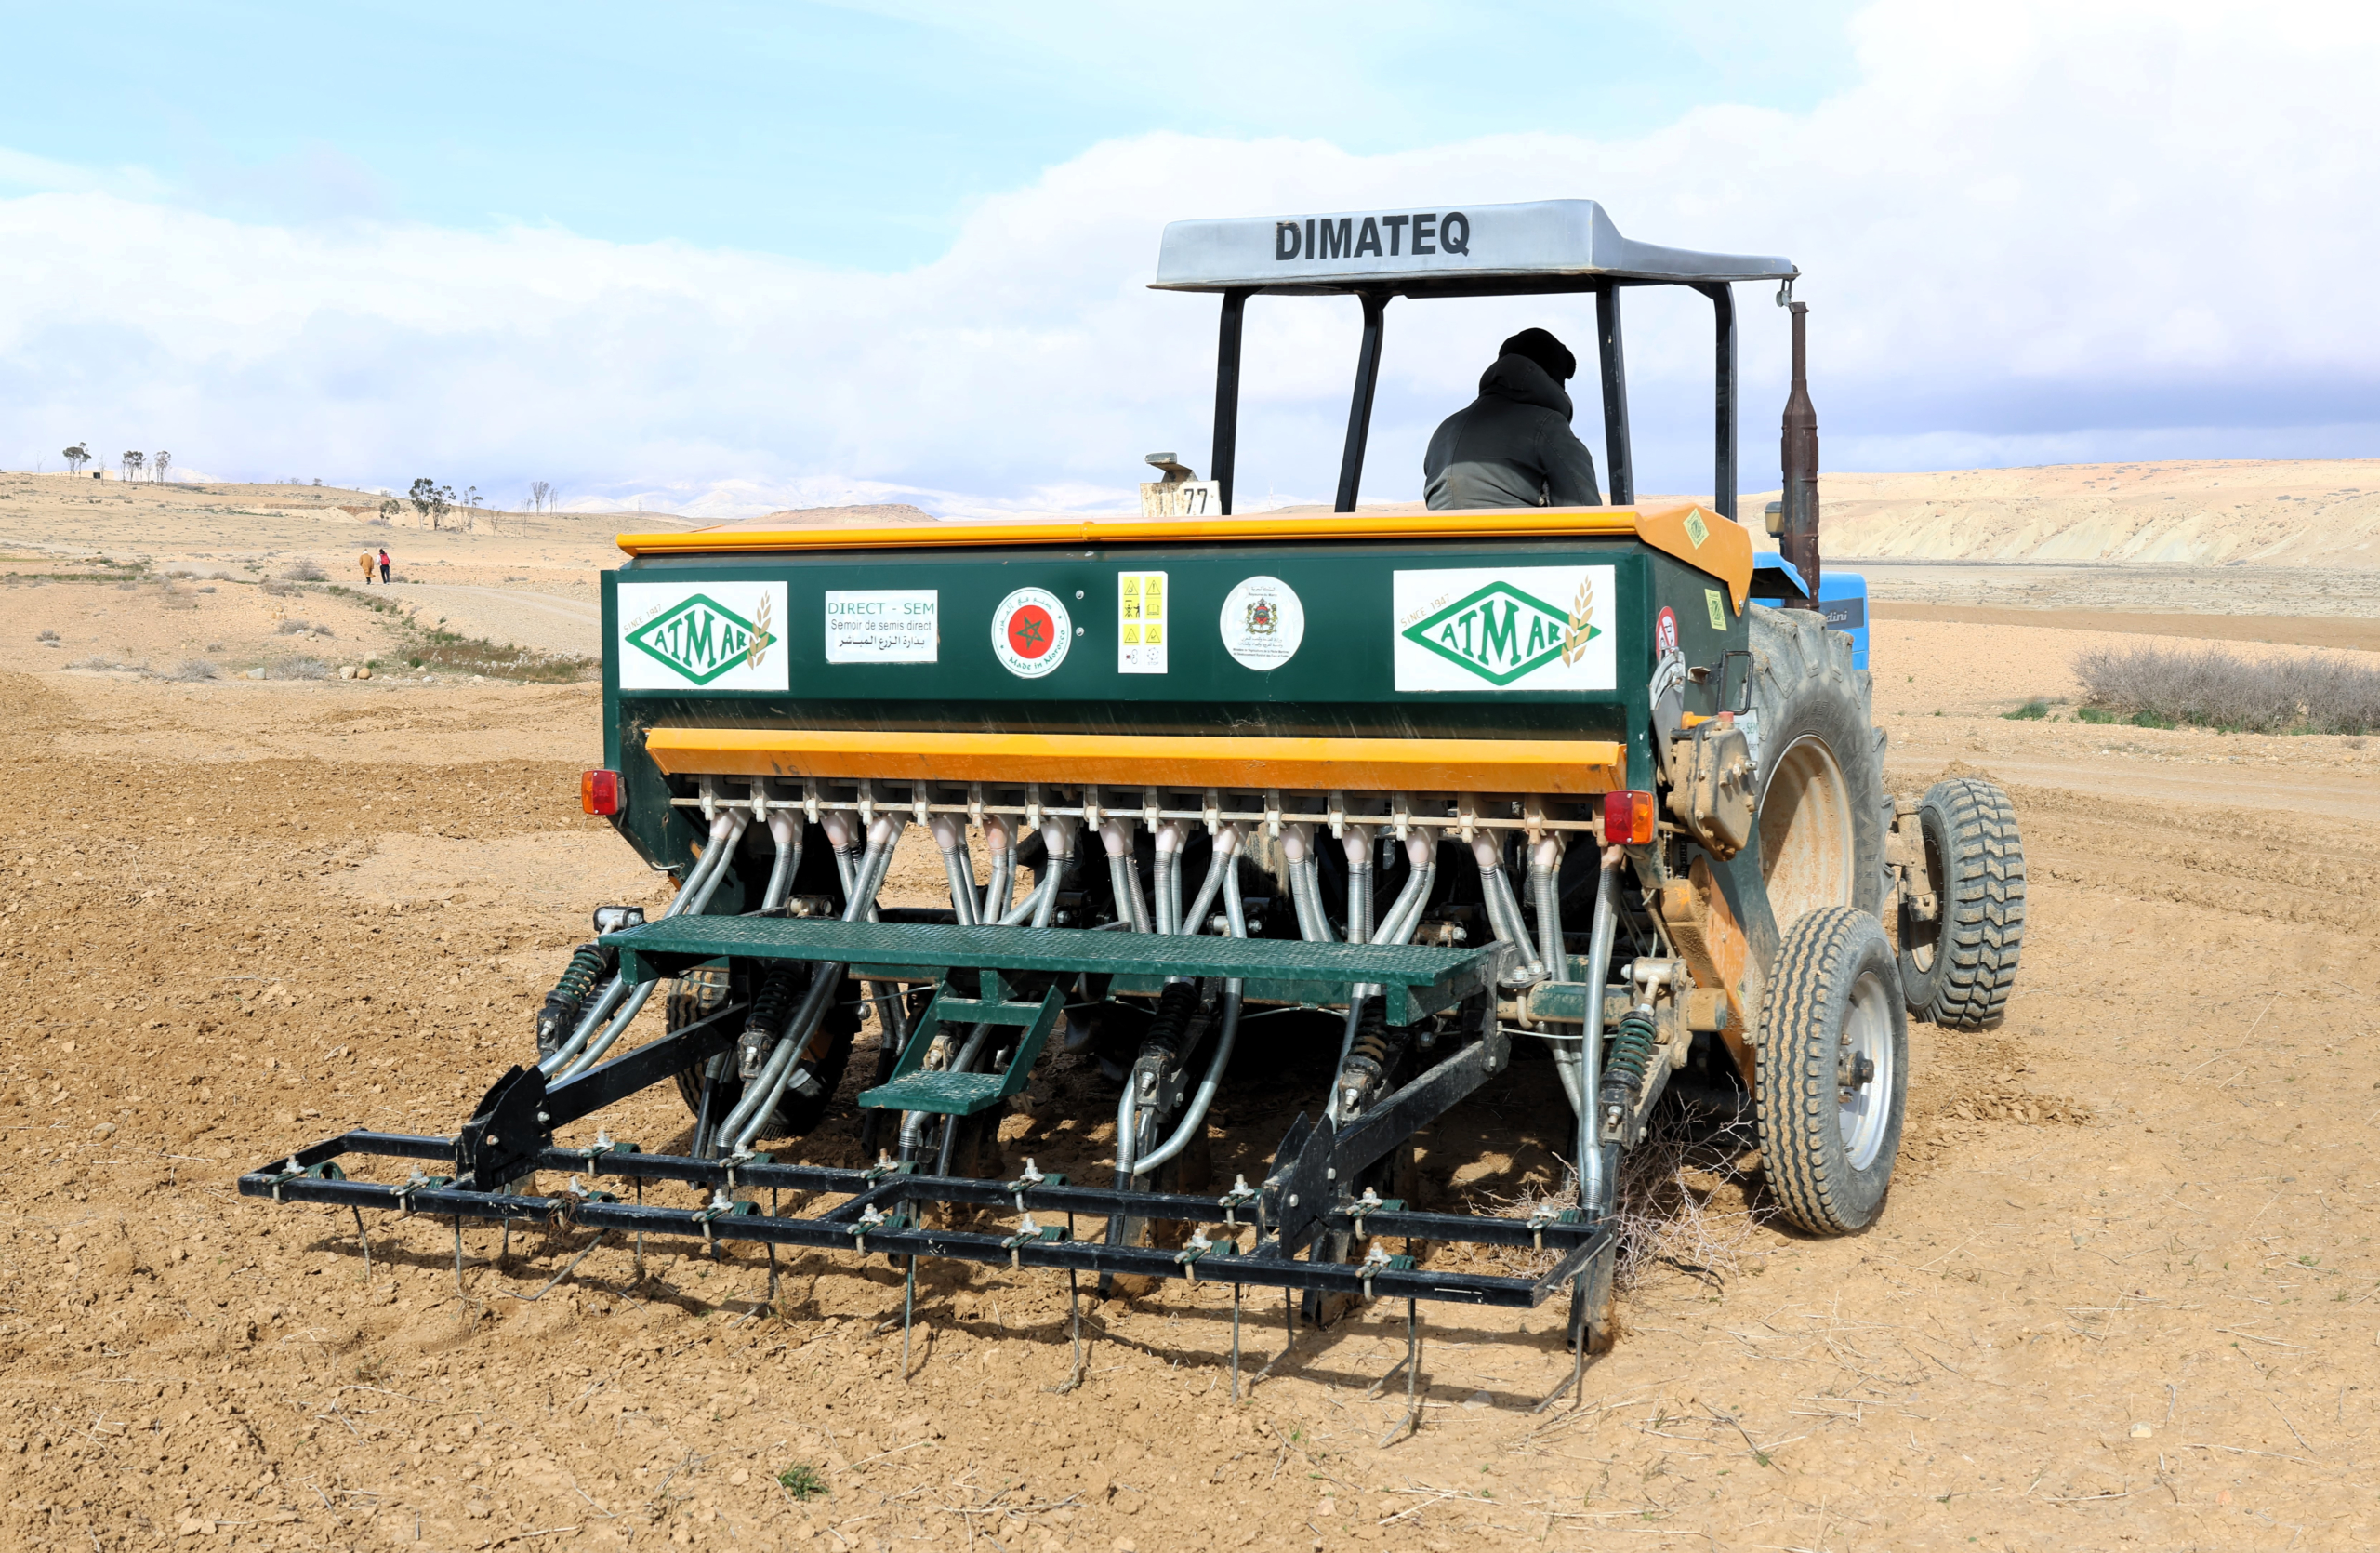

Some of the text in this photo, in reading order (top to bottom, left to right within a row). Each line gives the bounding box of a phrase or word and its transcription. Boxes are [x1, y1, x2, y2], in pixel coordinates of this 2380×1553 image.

[1276, 211, 1470, 261] DIMATEQ
[1183, 488, 1208, 515] 77
[623, 604, 663, 633] SINCE 1947
[827, 602, 886, 615] DIRECT
[903, 602, 934, 615] SEM
[1400, 593, 1450, 628] SINCE 1947
[1826, 610, 1848, 623] dini
[654, 609, 747, 669] ATMAR
[831, 618, 932, 631] Semoir de semis direct
[1441, 599, 1562, 667] ATMAR
[839, 635, 925, 650] بذارة الزرع المباشر
[1009, 656, 1031, 670] Made
[1043, 630, 1065, 665] Morocco
